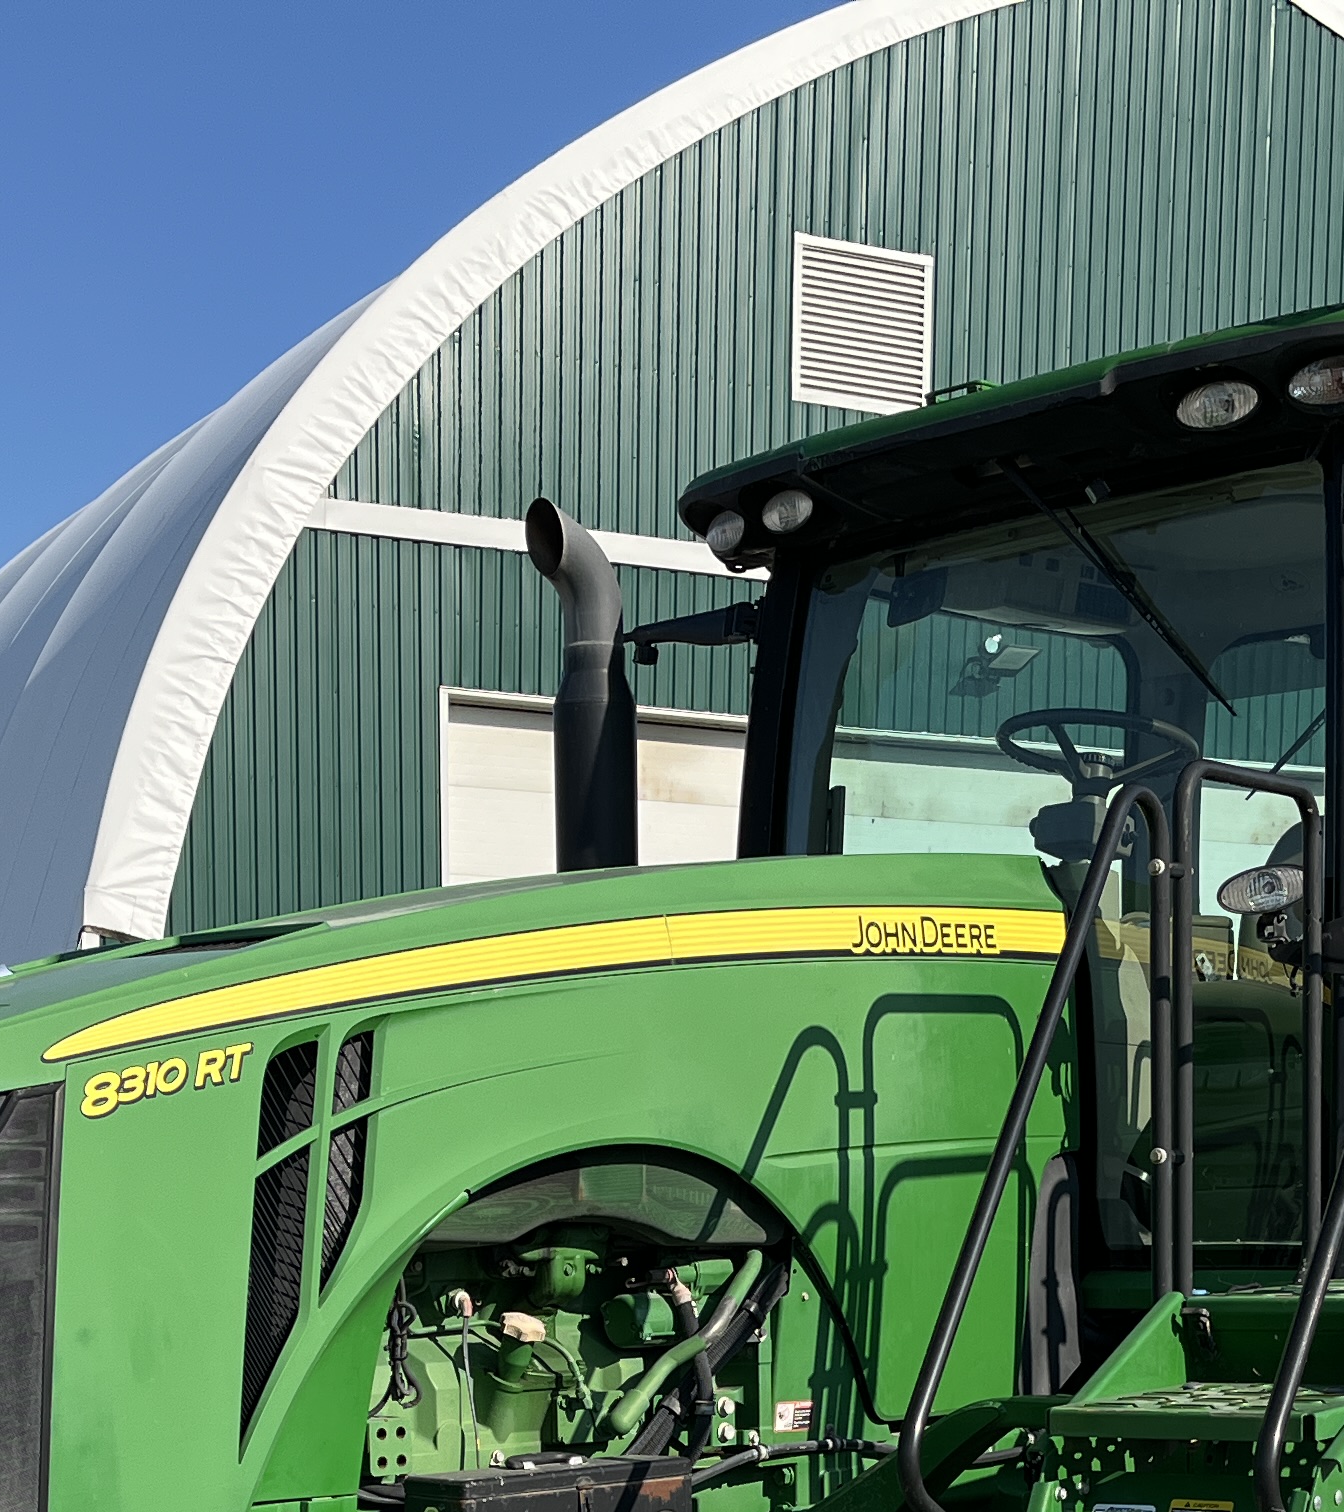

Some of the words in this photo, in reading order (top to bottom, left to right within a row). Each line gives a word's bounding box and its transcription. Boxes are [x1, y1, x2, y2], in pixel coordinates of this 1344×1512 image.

[852, 916, 917, 949] JOHN
[920, 916, 997, 949] DEERE
[80, 1057, 189, 1119] 8310
[194, 1041, 254, 1091] RT
